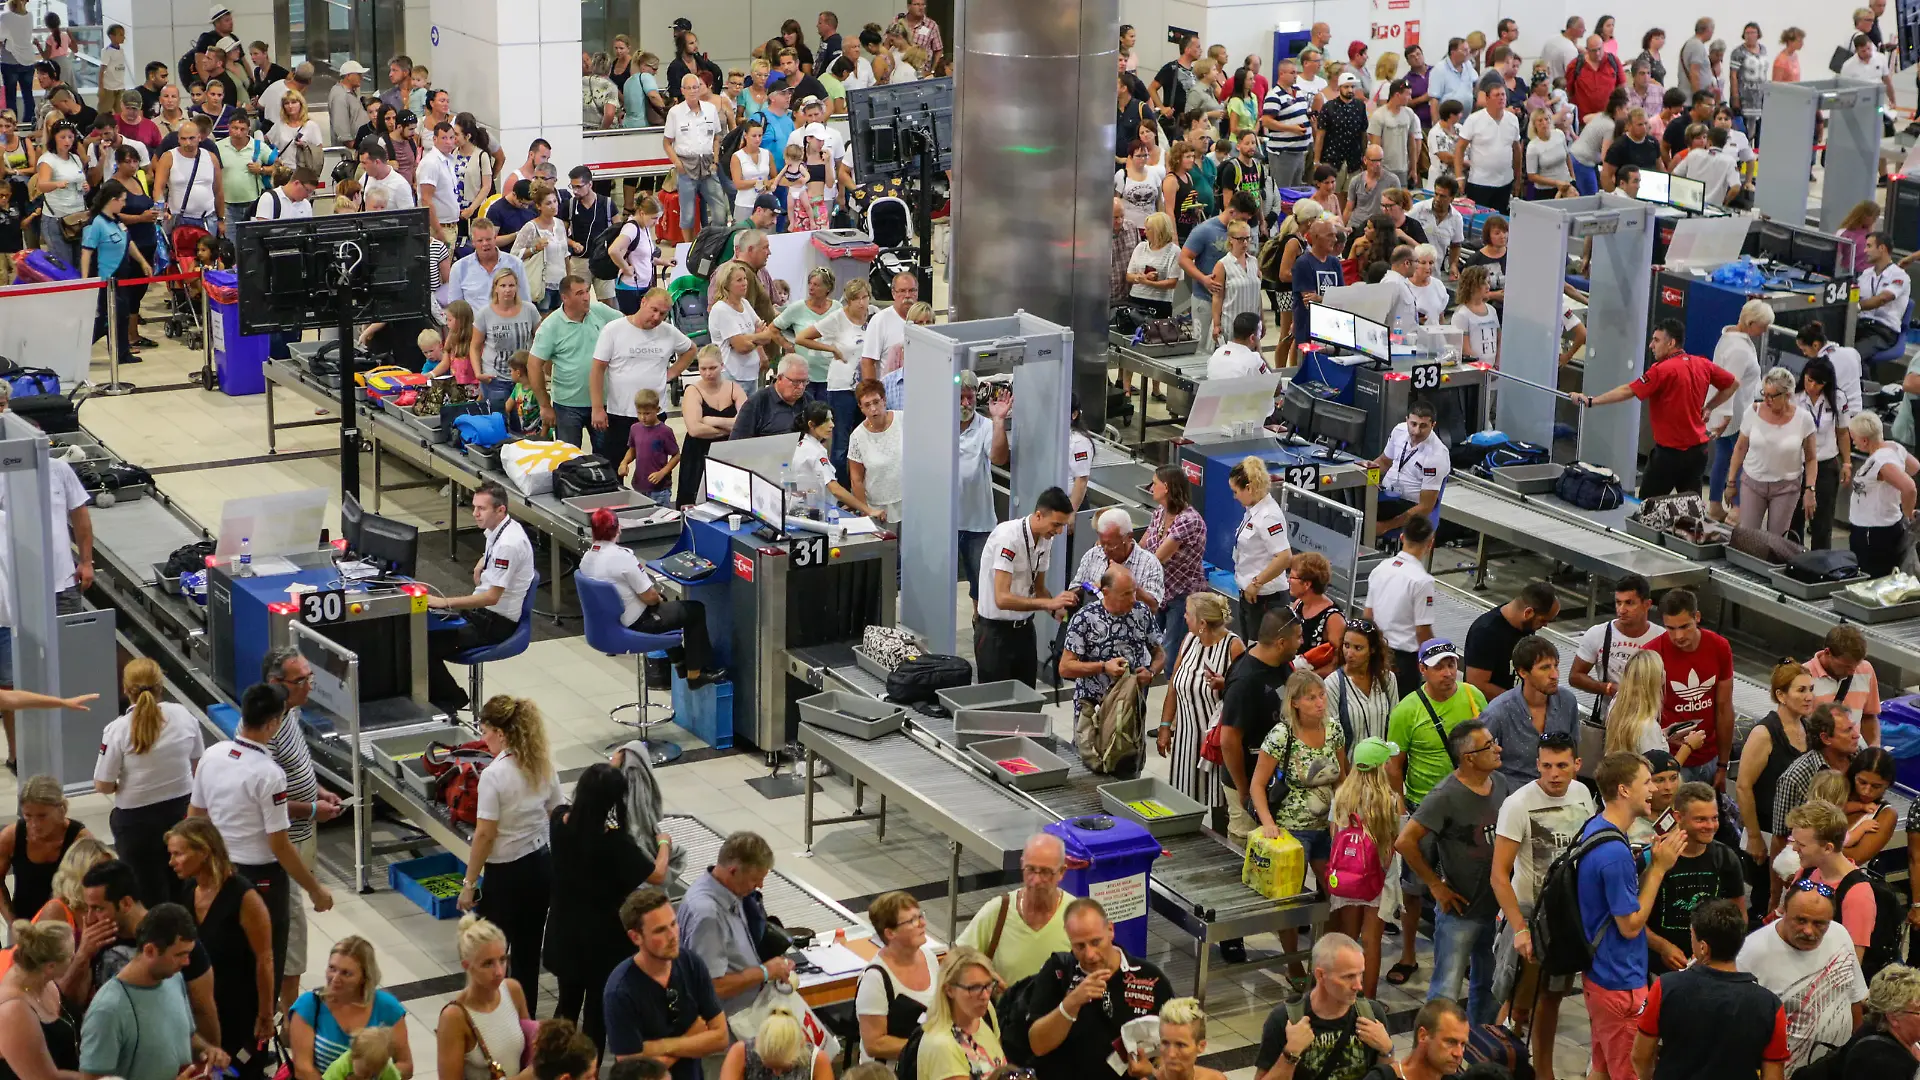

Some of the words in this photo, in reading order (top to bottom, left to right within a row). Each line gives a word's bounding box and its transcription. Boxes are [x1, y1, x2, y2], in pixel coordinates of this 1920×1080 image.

[1826, 282, 1847, 304] 34
[629, 347, 664, 355] BOGNER
[1414, 365, 1438, 389] 33
[1289, 466, 1316, 490] 32
[795, 538, 823, 566] 31
[305, 593, 341, 623] 30
[1675, 698, 1713, 712] adidas
[1124, 991, 1155, 1003] EXPERIENCE
